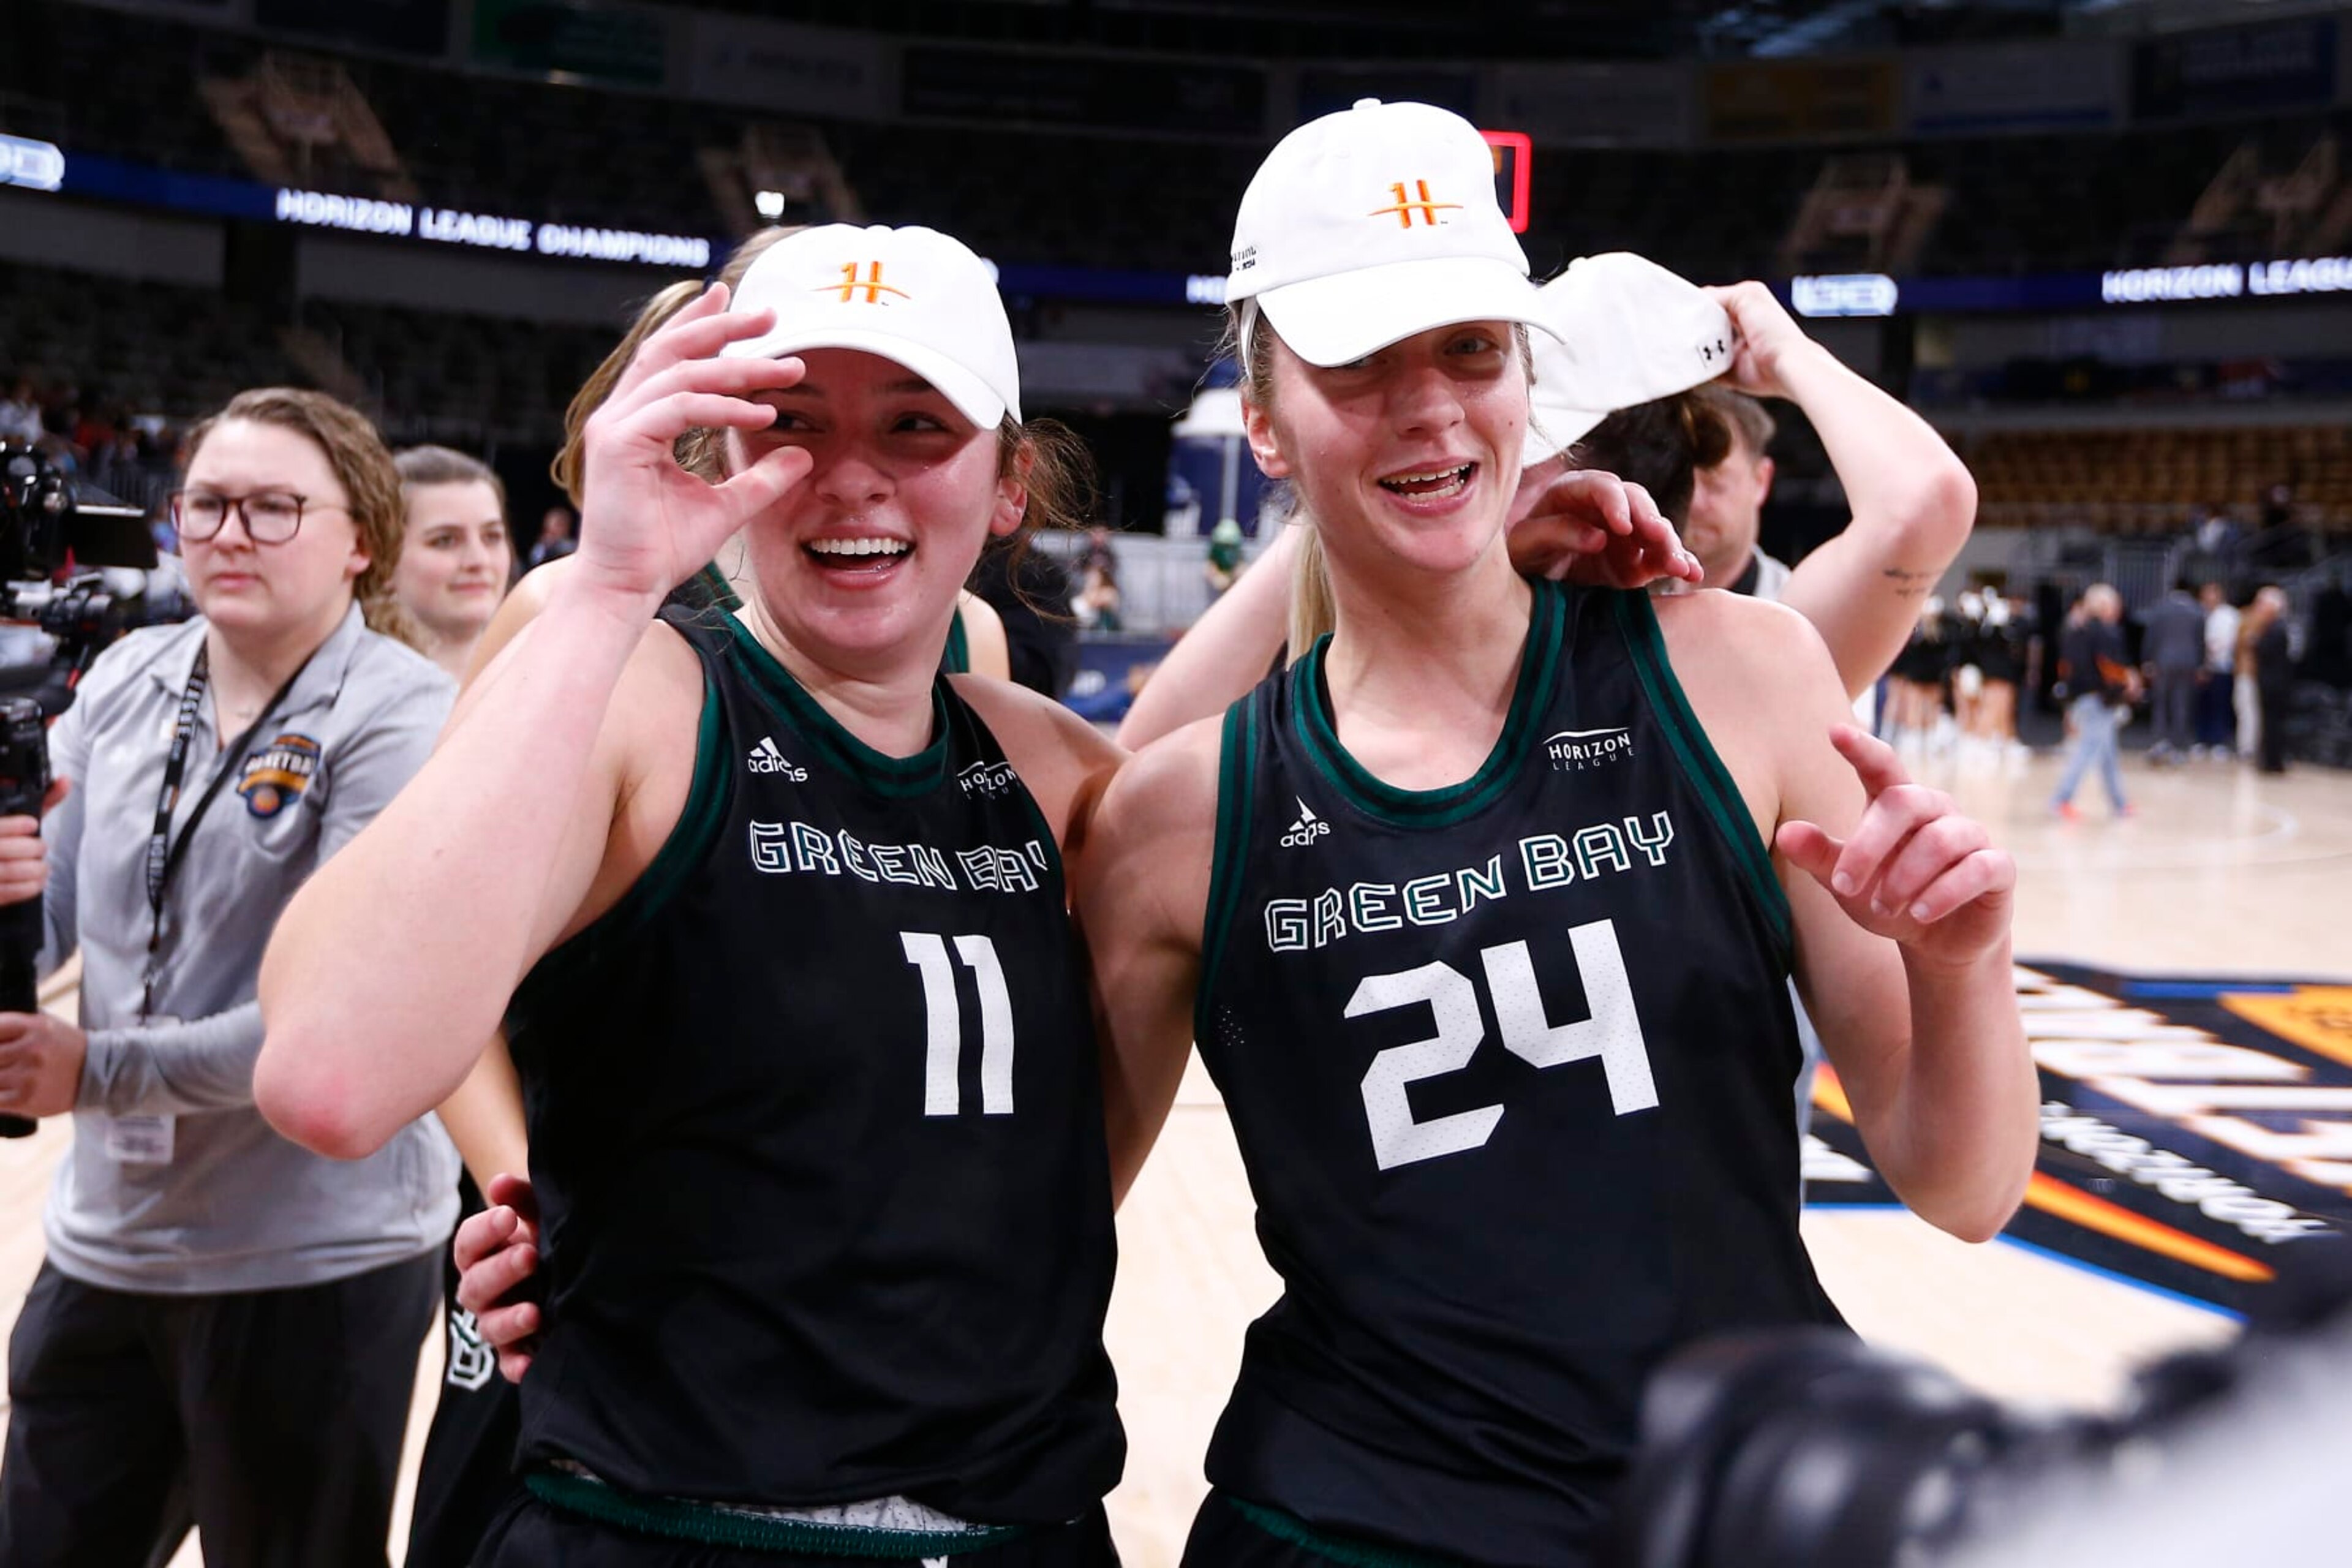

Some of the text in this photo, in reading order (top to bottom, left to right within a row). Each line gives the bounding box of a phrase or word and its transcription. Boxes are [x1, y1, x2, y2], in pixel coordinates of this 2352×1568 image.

[277, 187, 710, 268] HORIZON LEAGUE CHAMPIONS
[2102, 262, 2243, 303] HORIZON
[1548, 733, 1631, 760] HORIZON
[1553, 747, 1635, 771] LEAGUE
[750, 820, 957, 891] GREEN
[1264, 810, 1673, 952] GREEN BAY
[899, 931, 1014, 1116] 11
[1344, 918, 1659, 1170] 24
